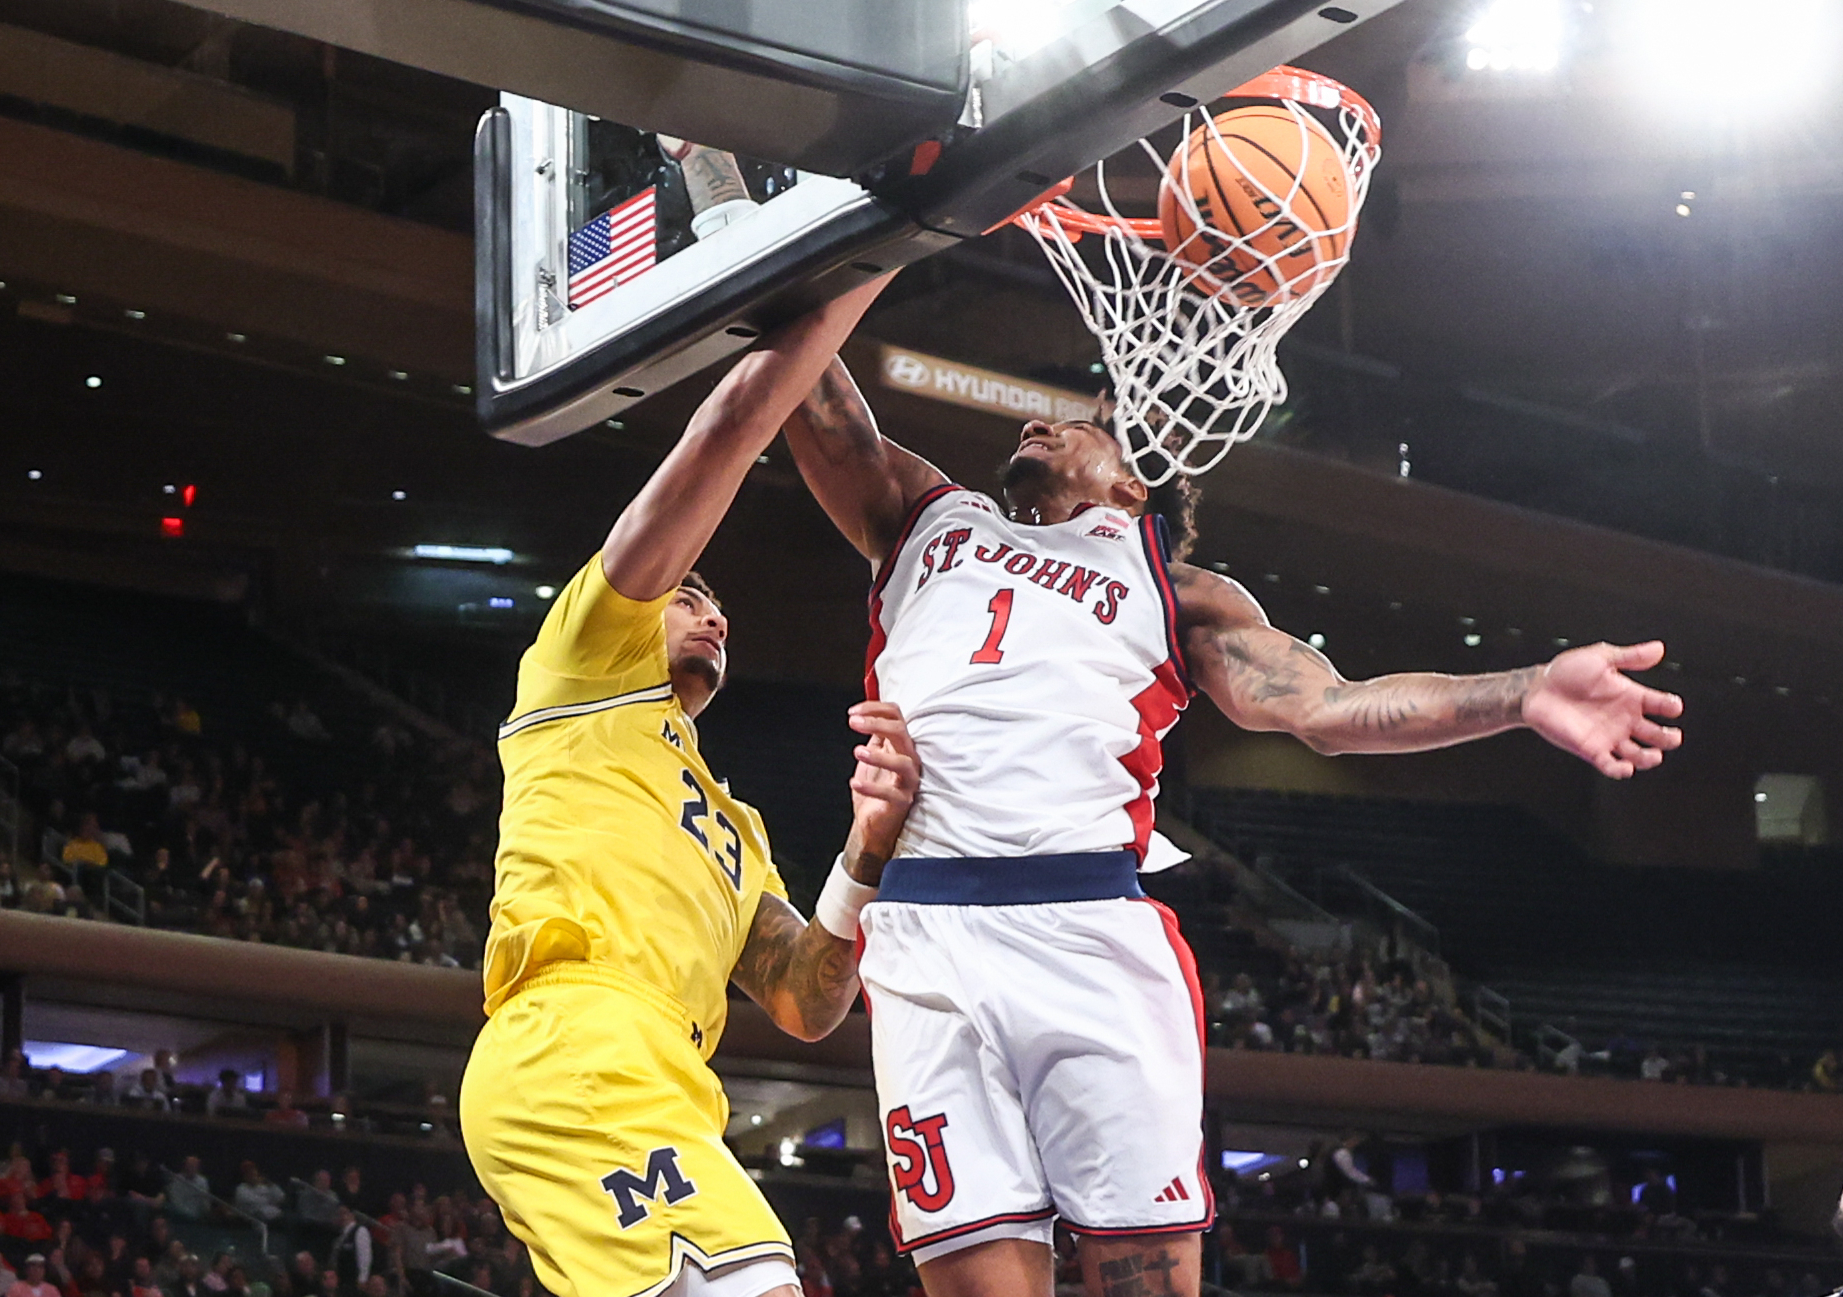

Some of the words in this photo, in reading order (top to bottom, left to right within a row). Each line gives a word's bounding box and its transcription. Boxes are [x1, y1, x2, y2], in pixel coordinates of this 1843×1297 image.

[934, 368, 1052, 417] HYUNDAI
[915, 528, 972, 594] ST.
[974, 542, 1129, 625] JOHN'S
[969, 588, 1014, 665] 1
[680, 767, 742, 891] 23
[600, 1146, 698, 1230] M
[886, 1104, 955, 1213] SJ
